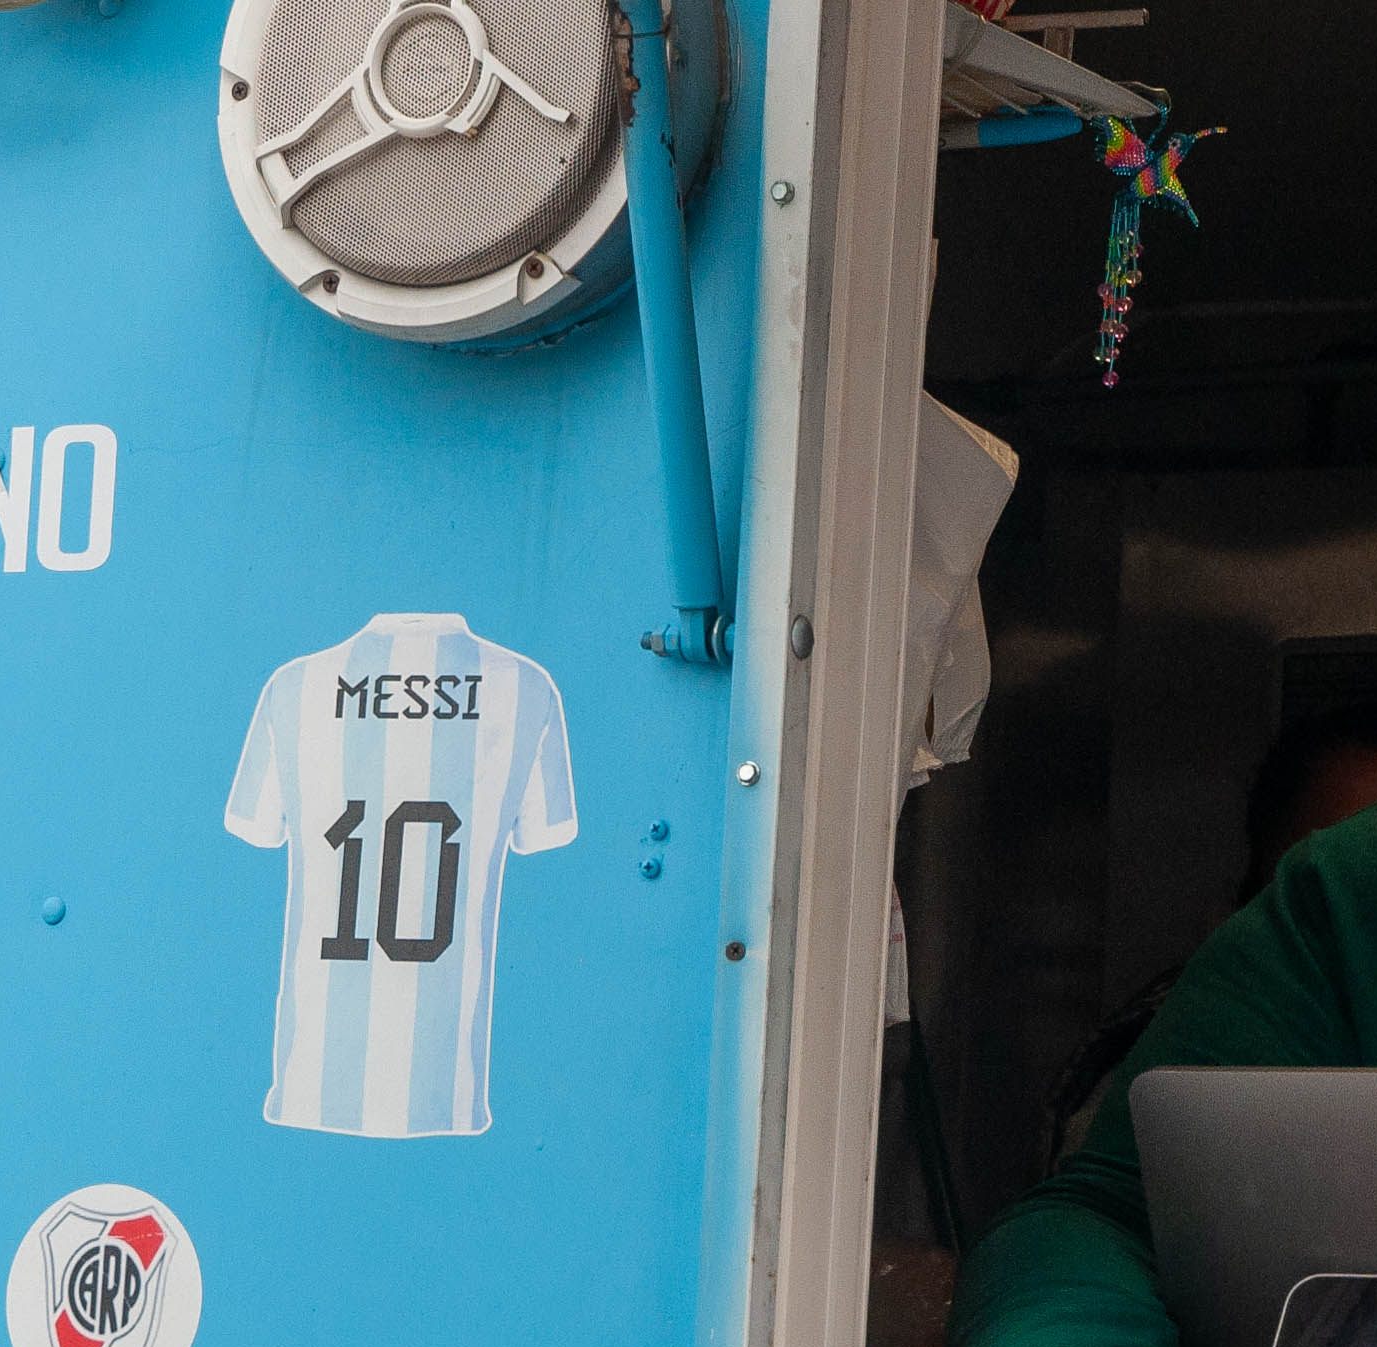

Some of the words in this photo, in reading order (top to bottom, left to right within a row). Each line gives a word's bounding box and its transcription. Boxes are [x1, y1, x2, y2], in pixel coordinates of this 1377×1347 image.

[334, 674, 483, 721] MESSI
[320, 799, 463, 963] 10
[68, 1243, 142, 1336] CARP
